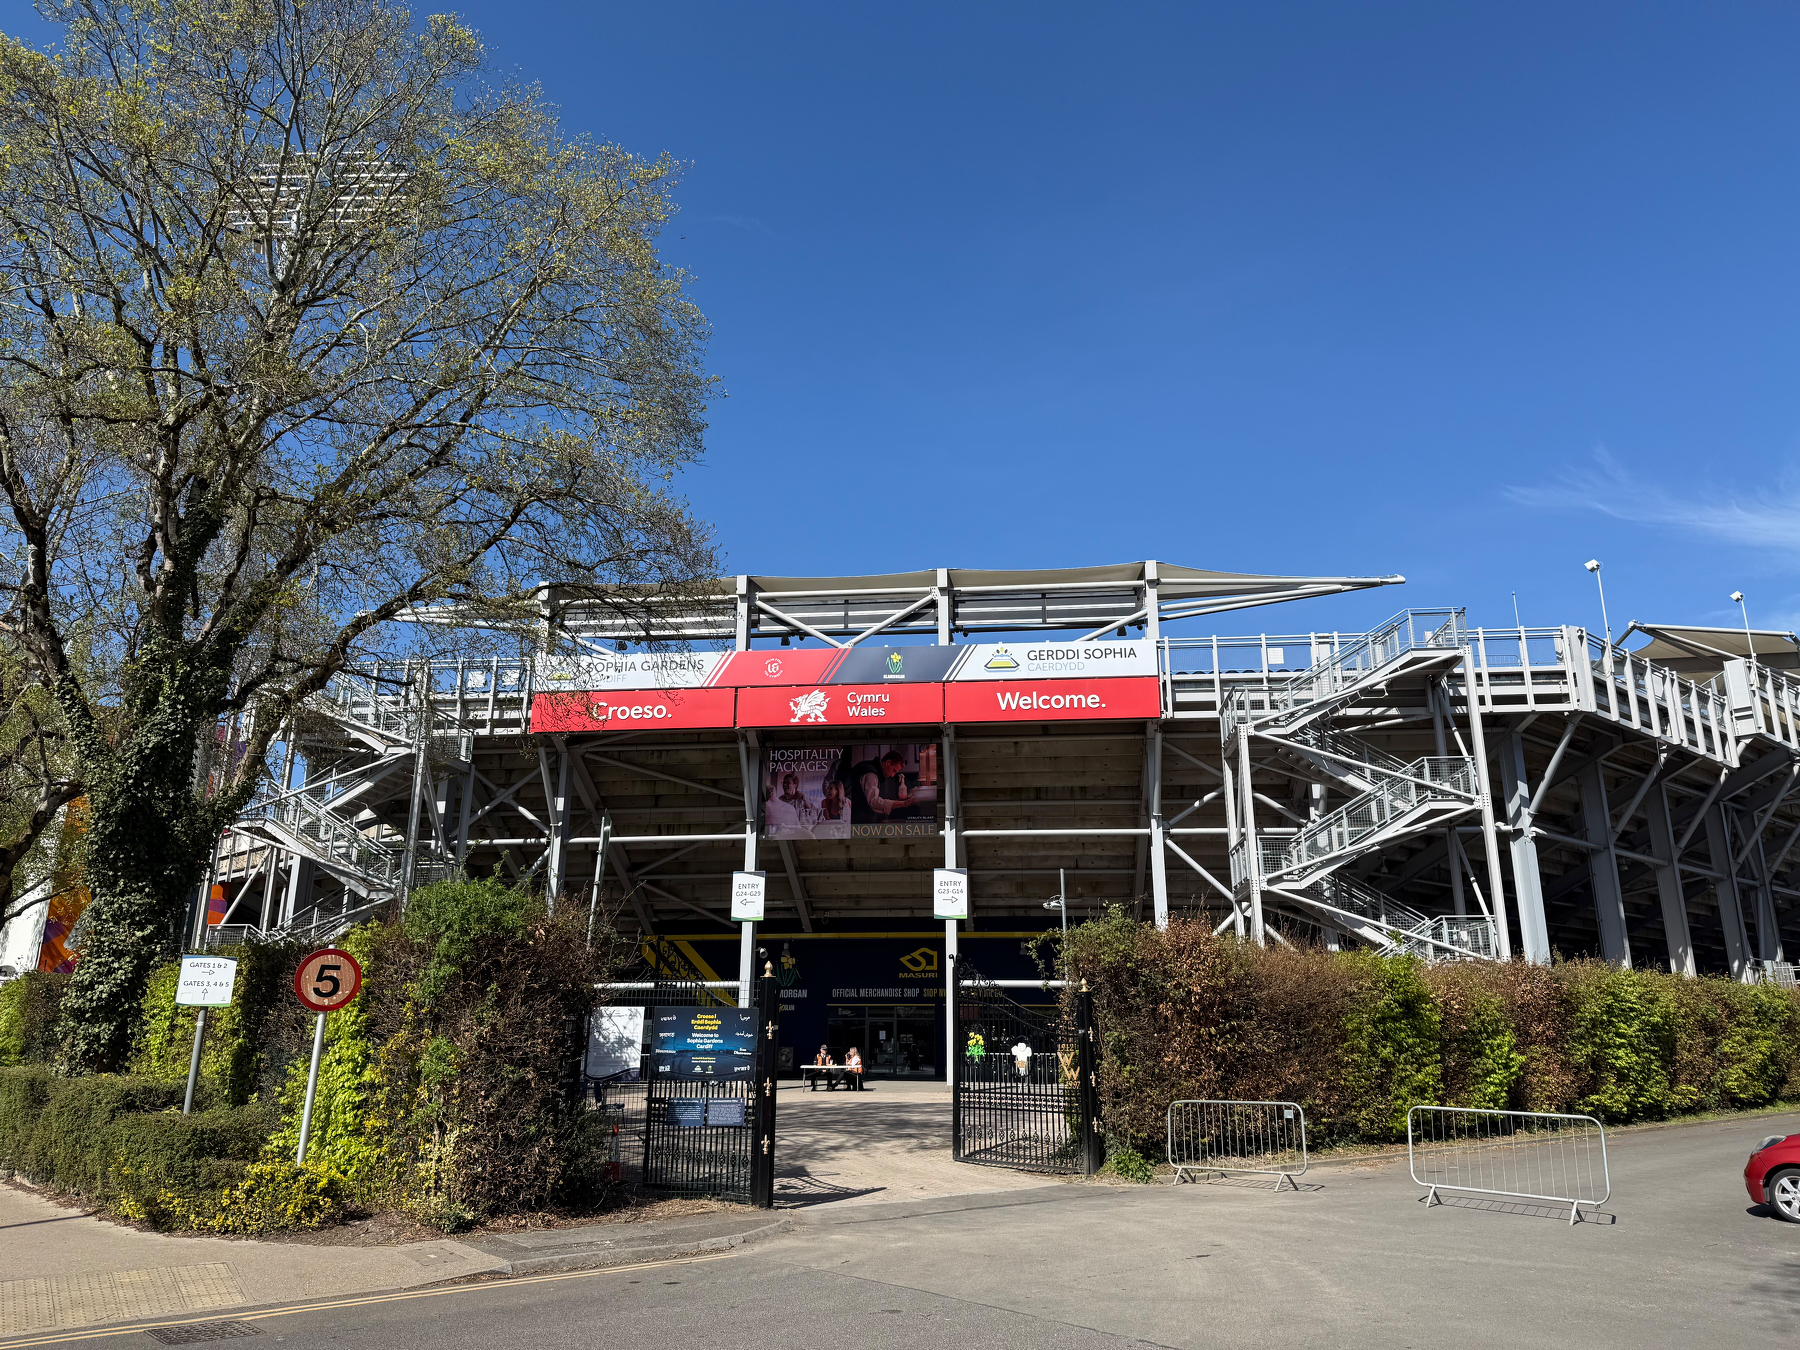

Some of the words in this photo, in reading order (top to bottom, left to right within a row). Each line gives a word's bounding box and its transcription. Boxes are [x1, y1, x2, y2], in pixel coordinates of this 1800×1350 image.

[1027, 649, 1080, 661] GERDDI
[1084, 647, 1137, 660] SOPHIA
[586, 661, 637, 673] SOPHIA
[641, 659, 704, 672] GARDENS
[1027, 661, 1085, 672] CAERDYDD
[847, 692, 890, 706] Cymru
[996, 691, 1106, 710] Welcome.
[592, 702, 672, 720] Croeso.
[847, 706, 885, 717] Wales
[769, 748, 844, 761] HOSPITALITY
[769, 760, 828, 773] PACKAGES
[852, 825, 883, 837] NOW
[884, 825, 903, 836] ON
[906, 824, 934, 836] SALE
[312, 964, 342, 998] 5
[832, 988, 858, 998] OFFICIAL
[859, 988, 902, 998] MERCHANDISE
[903, 987, 920, 998] SHOP
[1057, 1044, 1075, 1052] 1912
